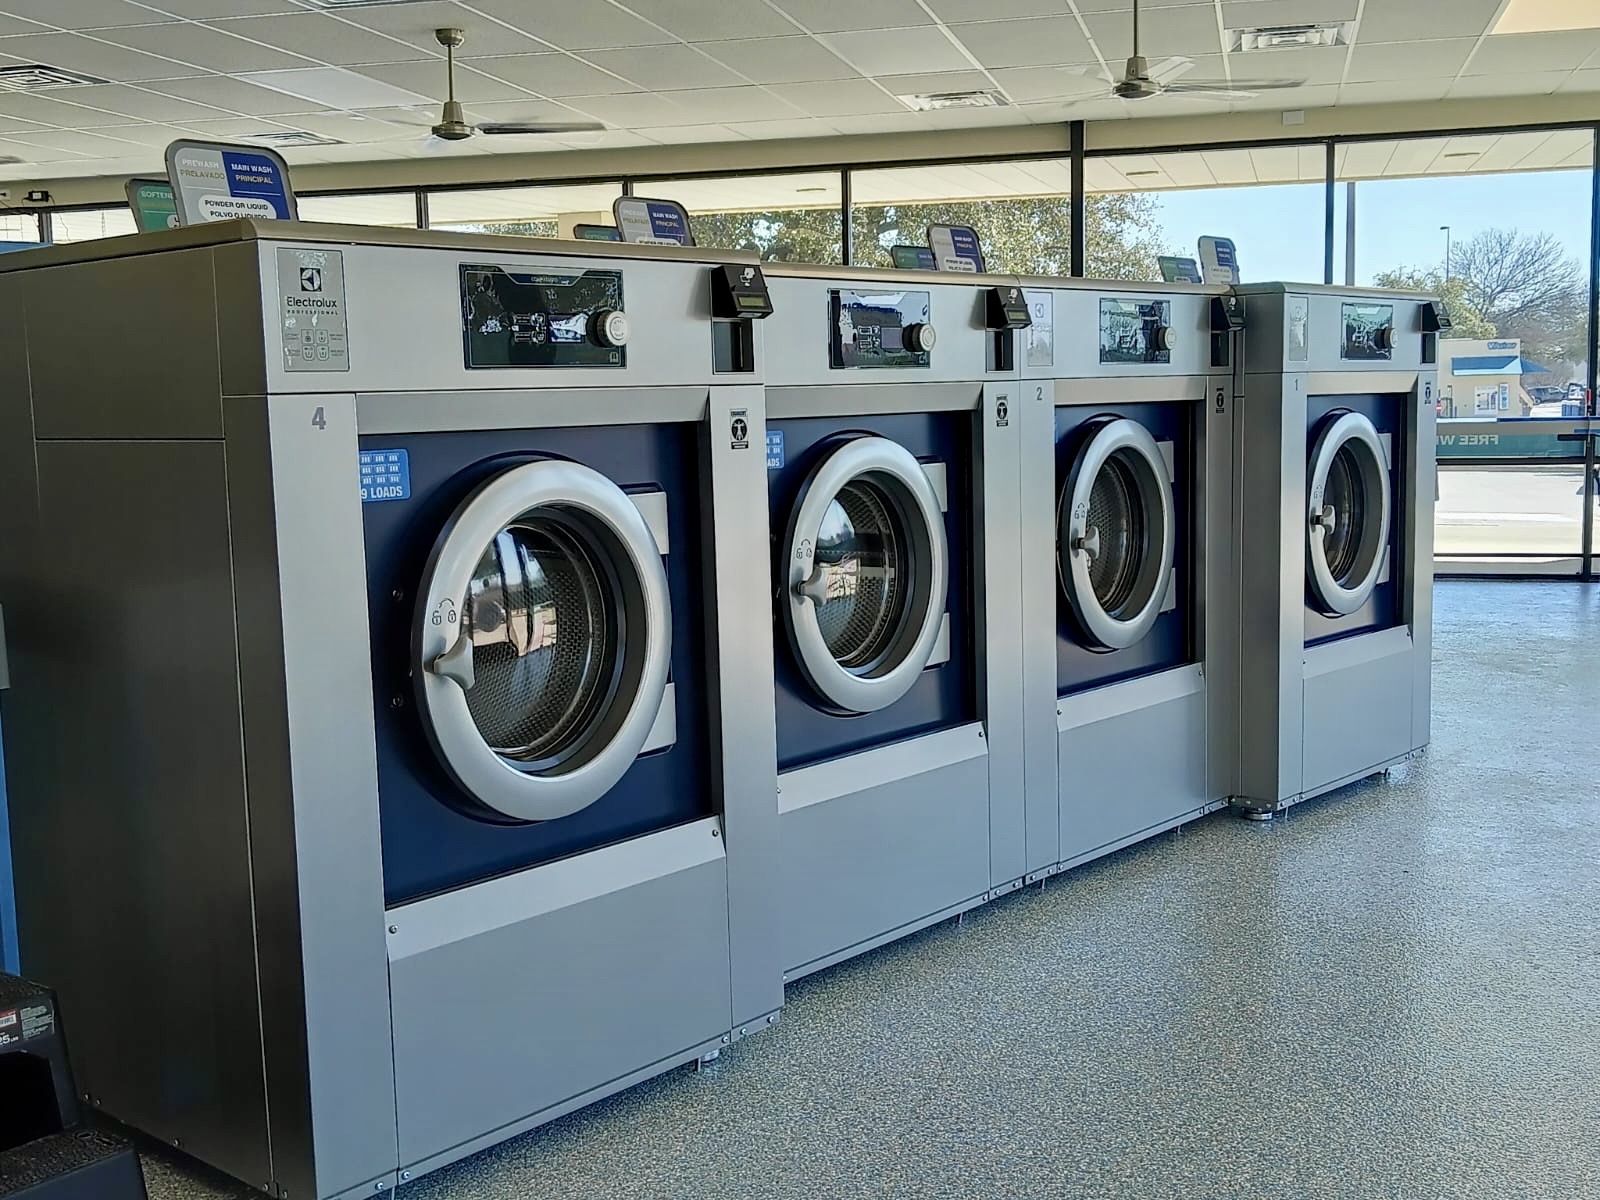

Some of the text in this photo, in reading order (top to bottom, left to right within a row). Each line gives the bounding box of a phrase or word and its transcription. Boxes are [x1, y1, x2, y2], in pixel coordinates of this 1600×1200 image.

[182, 158, 219, 169] PREWASH
[231, 163, 273, 174] MAIN WASH
[180, 169, 225, 180] PRELAVADO
[235, 174, 273, 184] PRINCIPAL
[204, 199, 269, 211] POWDER OR LIQUID
[210, 210, 233, 218] POLVO
[286, 296, 337, 308] Electrolux
[1036, 386, 1043, 400] 2
[311, 406, 327, 430] 4
[360, 485, 403, 499] 9 LOADS
